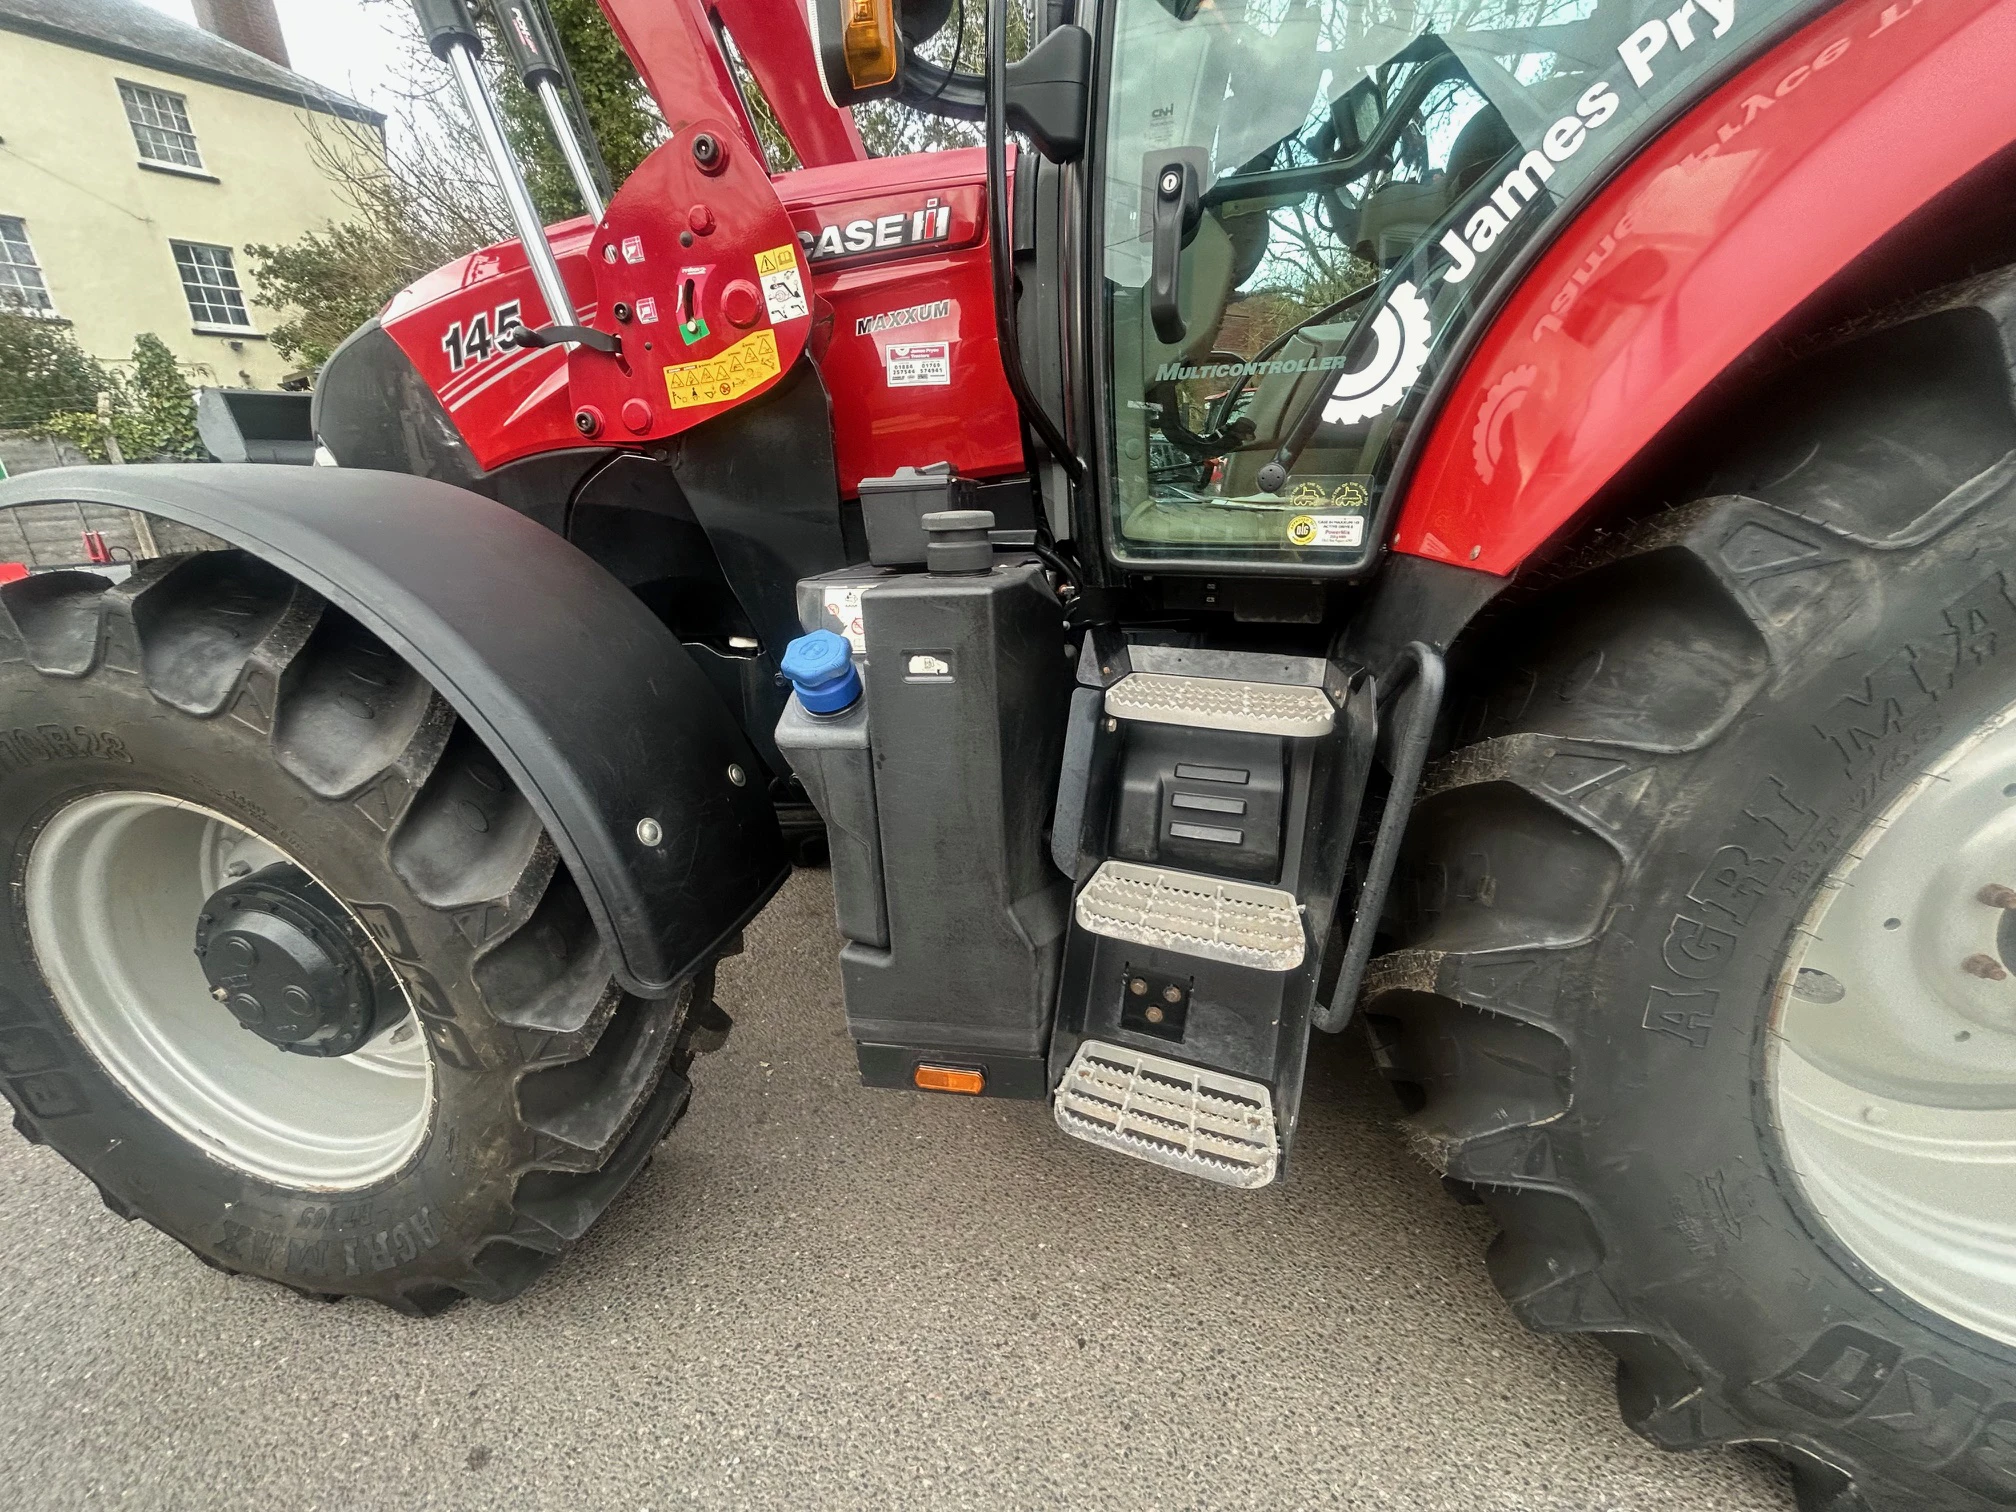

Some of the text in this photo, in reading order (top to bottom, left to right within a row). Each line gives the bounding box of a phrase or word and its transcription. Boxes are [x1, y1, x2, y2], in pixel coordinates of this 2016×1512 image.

[1442, 0, 1736, 284] James Pry
[441, 298, 525, 373] 145
[856, 299, 951, 337] MAXXUM
